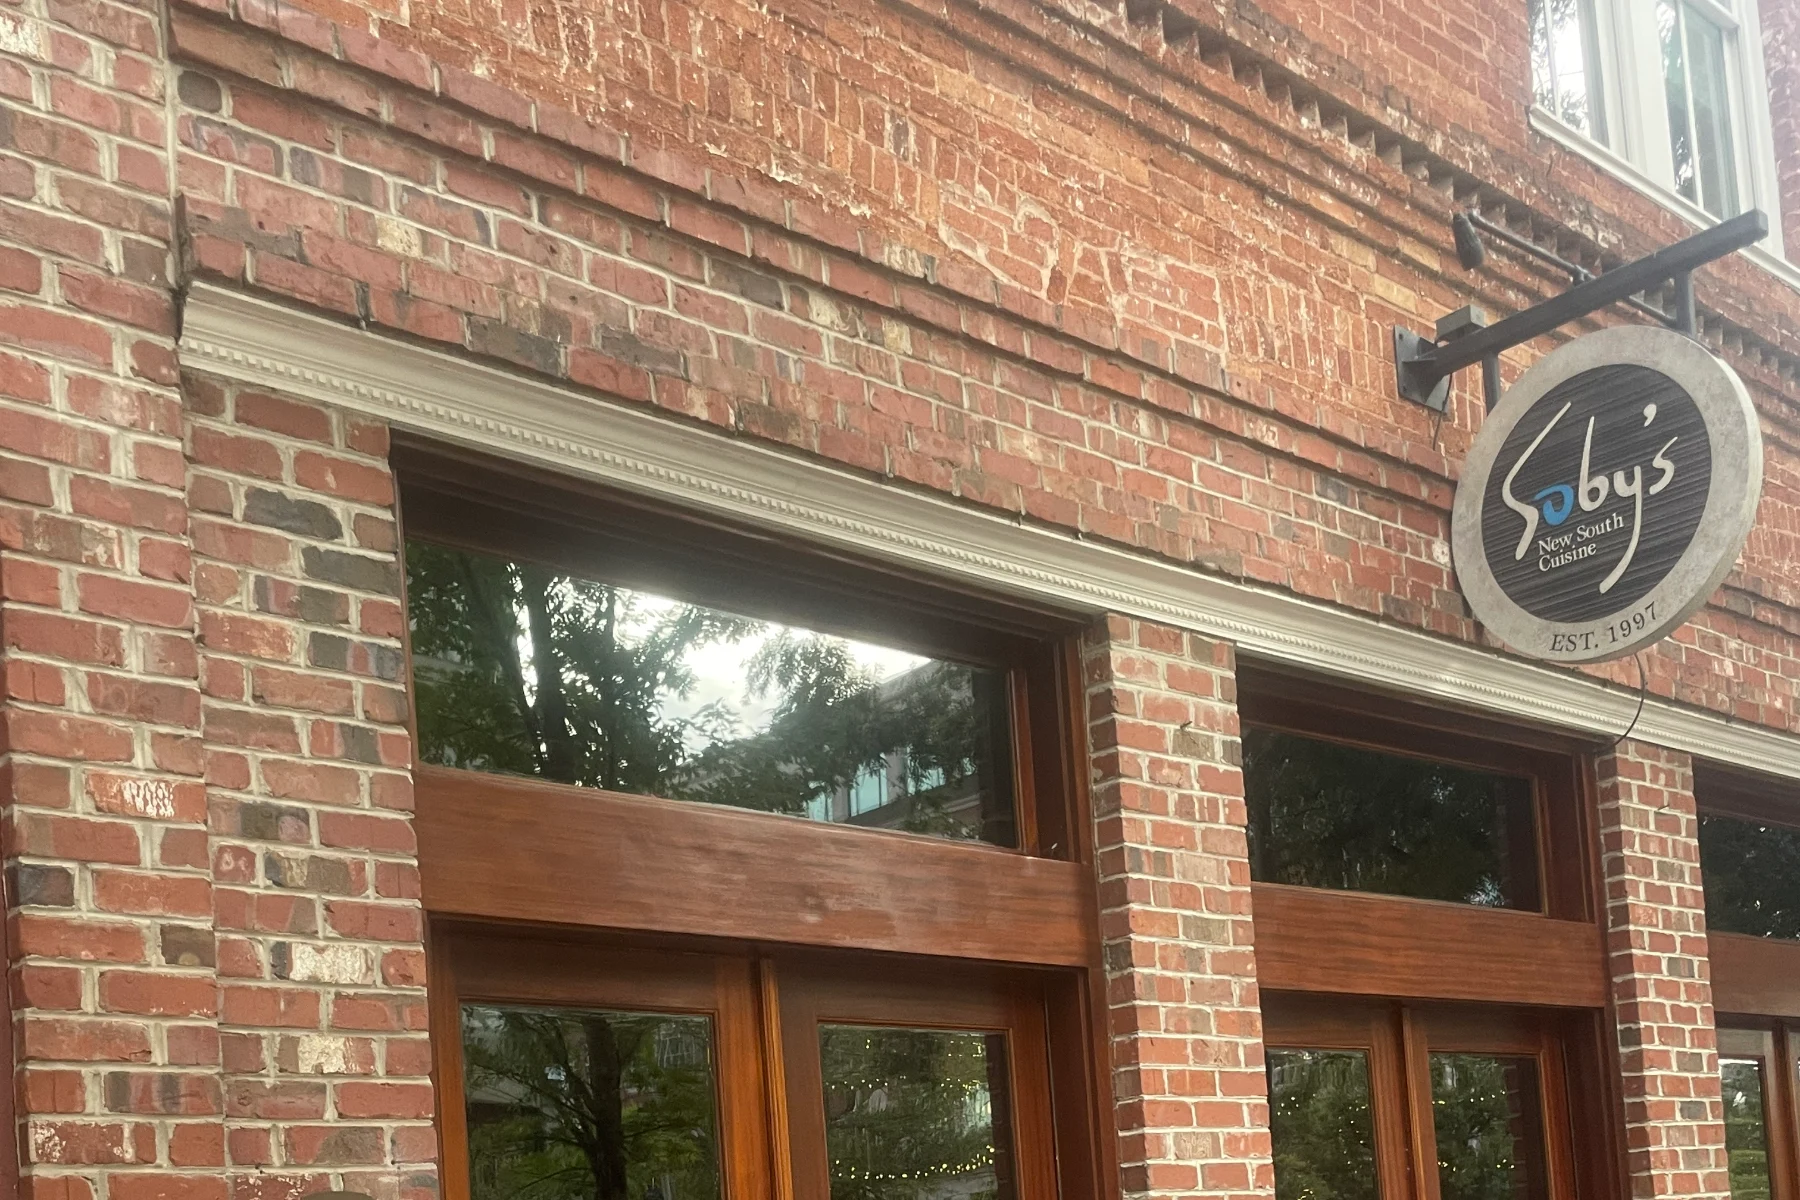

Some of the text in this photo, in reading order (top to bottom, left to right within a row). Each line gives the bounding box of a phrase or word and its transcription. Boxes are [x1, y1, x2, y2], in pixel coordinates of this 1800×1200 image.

[1502, 401, 1679, 594] Soby's
[1538, 513, 1625, 557] New South
[1538, 542, 1597, 573] Cuisine
[1550, 601, 1658, 652] EST. 1997
